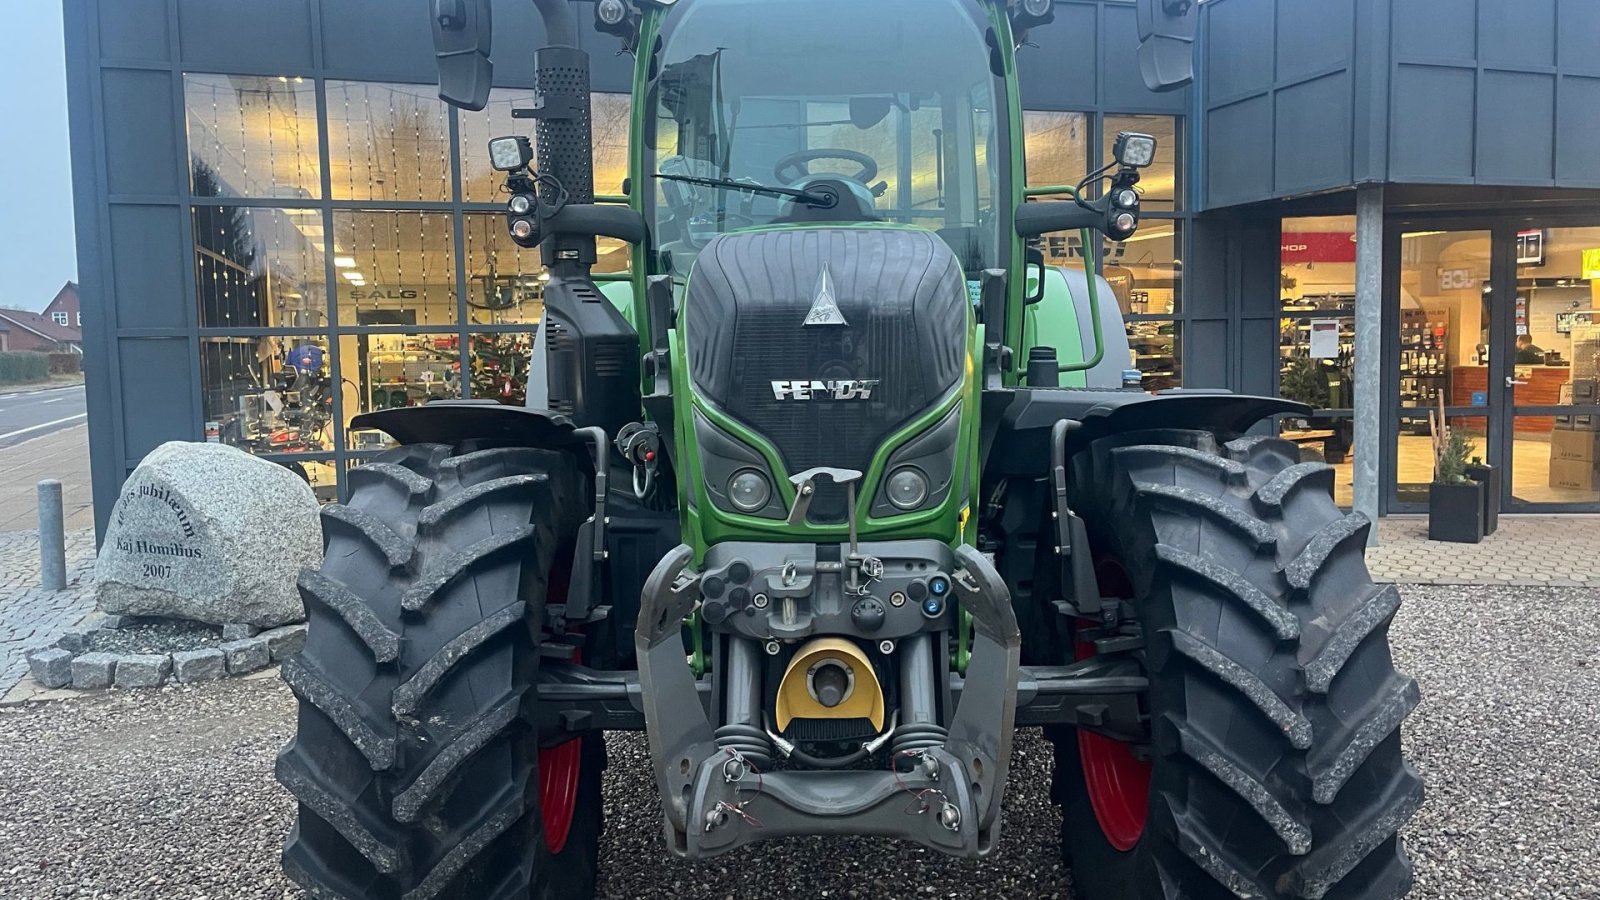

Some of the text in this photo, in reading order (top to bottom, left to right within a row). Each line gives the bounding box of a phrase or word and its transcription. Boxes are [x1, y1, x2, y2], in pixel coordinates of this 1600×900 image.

[350, 290, 417, 299] SALG
[771, 379, 880, 400] FENDT
[138, 481, 195, 538] jubilæum
[116, 536, 202, 559] Kaj Homilius
[143, 563, 172, 578] 2007
